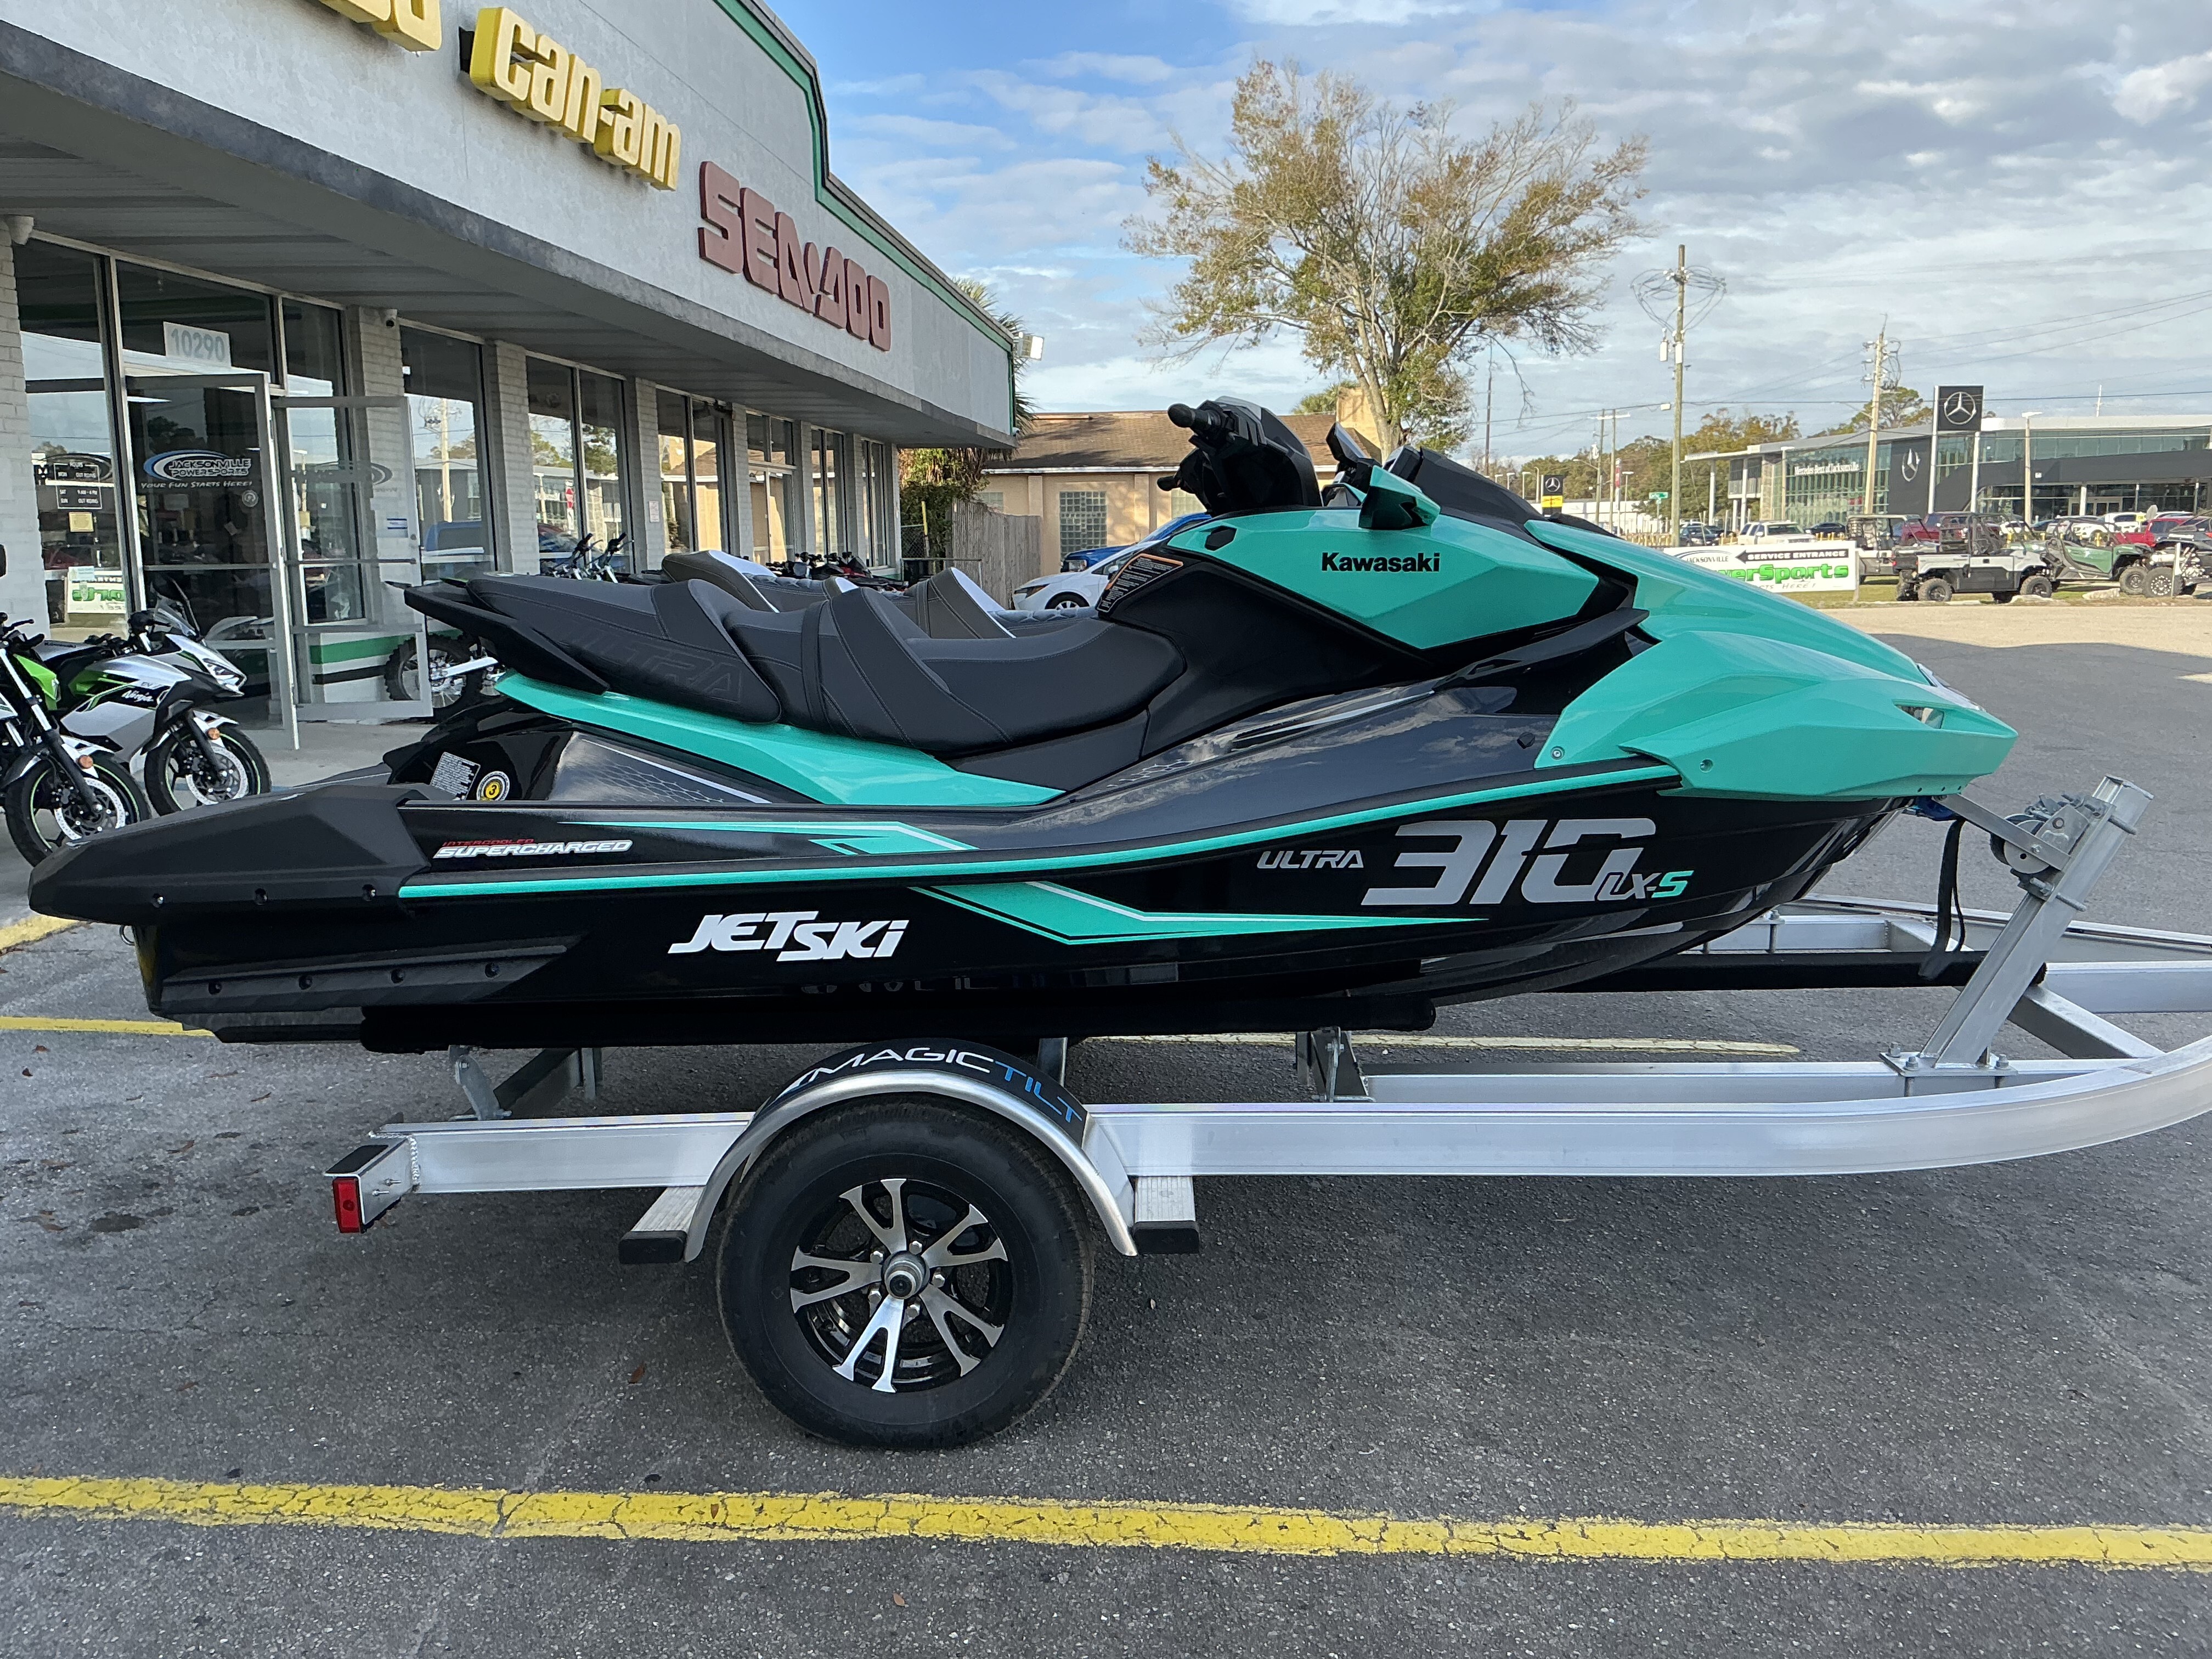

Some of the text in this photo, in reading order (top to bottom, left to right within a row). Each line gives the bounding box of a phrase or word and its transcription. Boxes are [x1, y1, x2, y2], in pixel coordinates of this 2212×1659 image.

[171, 328, 225, 362] 10290
[168, 458, 251, 469] JACKSONVILLE
[172, 468, 249, 477] POWERSPORTS
[1793, 550, 1846, 558] ENTRANCE
[1322, 552, 1440, 572] Kawasaki
[1717, 563, 1849, 584] werSports
[121, 690, 154, 702] Ninja
[488, 785, 497, 795] 3
[432, 840, 633, 859] SUPERCHARGED
[1256, 850, 1364, 868] ULTRA
[1361, 817, 1656, 905] 310
